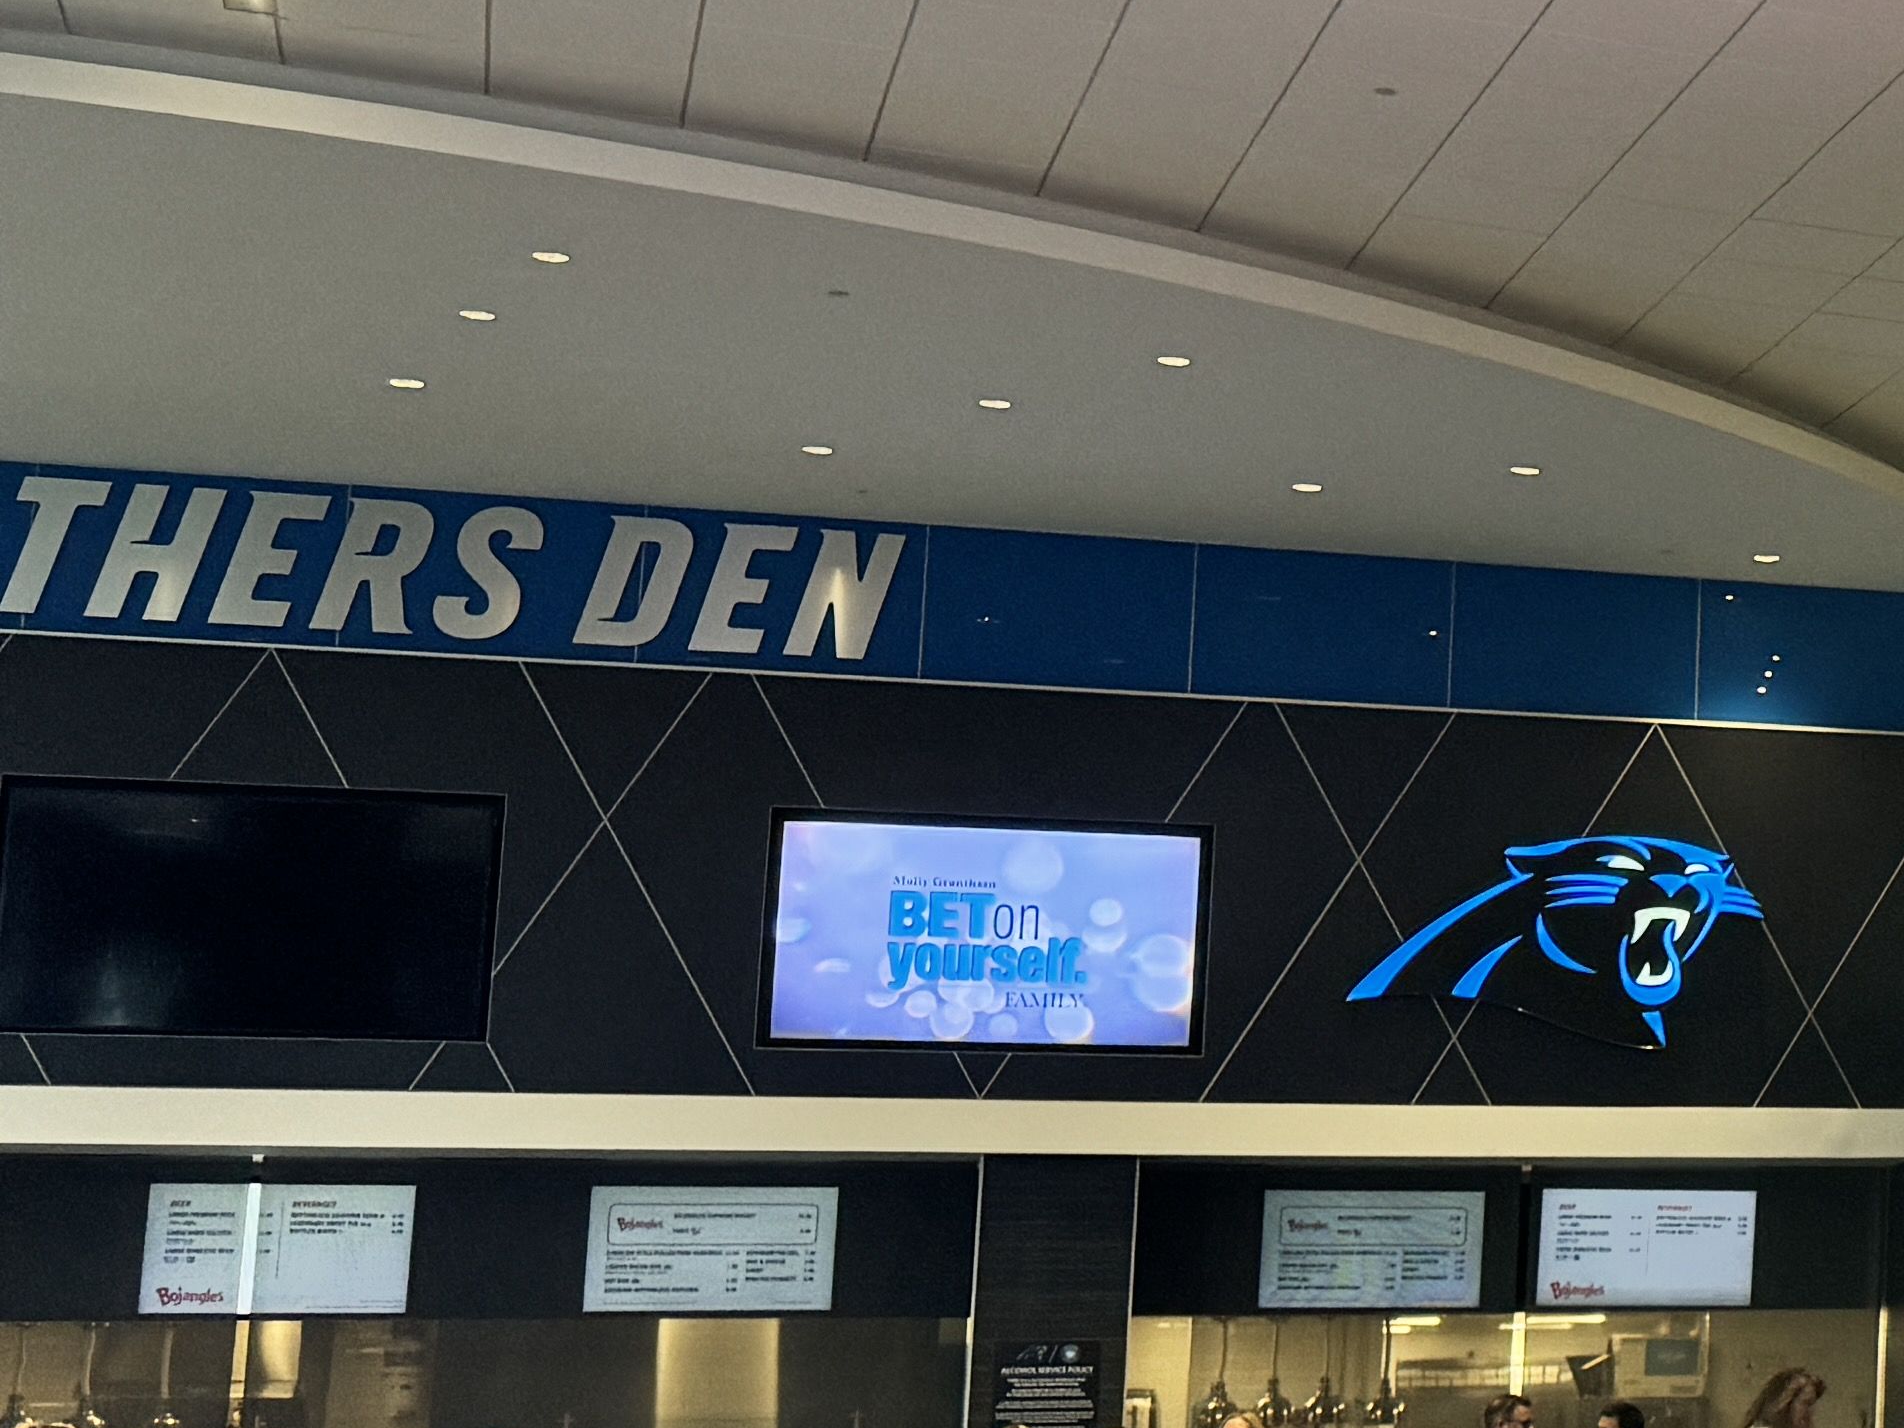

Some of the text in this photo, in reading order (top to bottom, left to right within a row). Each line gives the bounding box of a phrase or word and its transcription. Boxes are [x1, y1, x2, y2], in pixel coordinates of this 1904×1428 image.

[0, 475, 906, 660] THERS DEN
[888, 890, 1040, 940] BET on
[887, 936, 1087, 991] yourself.
[1005, 991, 1084, 1009] FAMILY
[156, 1285, 223, 1306] Bojangles
